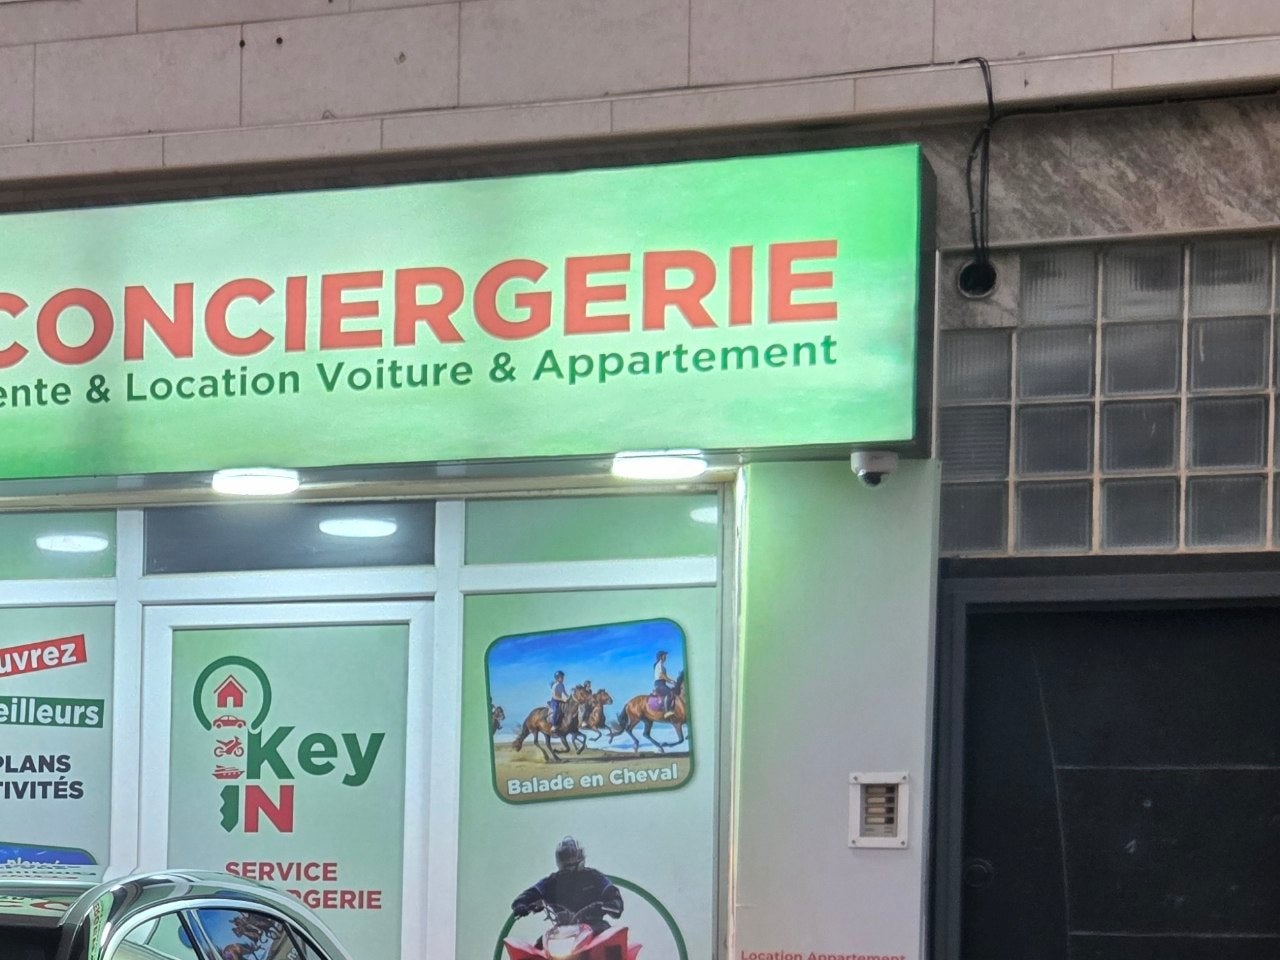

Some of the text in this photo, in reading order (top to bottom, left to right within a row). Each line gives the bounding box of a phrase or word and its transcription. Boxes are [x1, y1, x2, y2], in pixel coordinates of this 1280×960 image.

[86, 374, 111, 403] &
[126, 366, 300, 402] Location
[317, 357, 474, 393] Voiture
[490, 351, 516, 383] &
[533, 335, 837, 385] Appartement
[246, 726, 386, 787] Key
[507, 764, 678, 795] Balade en Cheval
[225, 862, 338, 881] SERVICE
